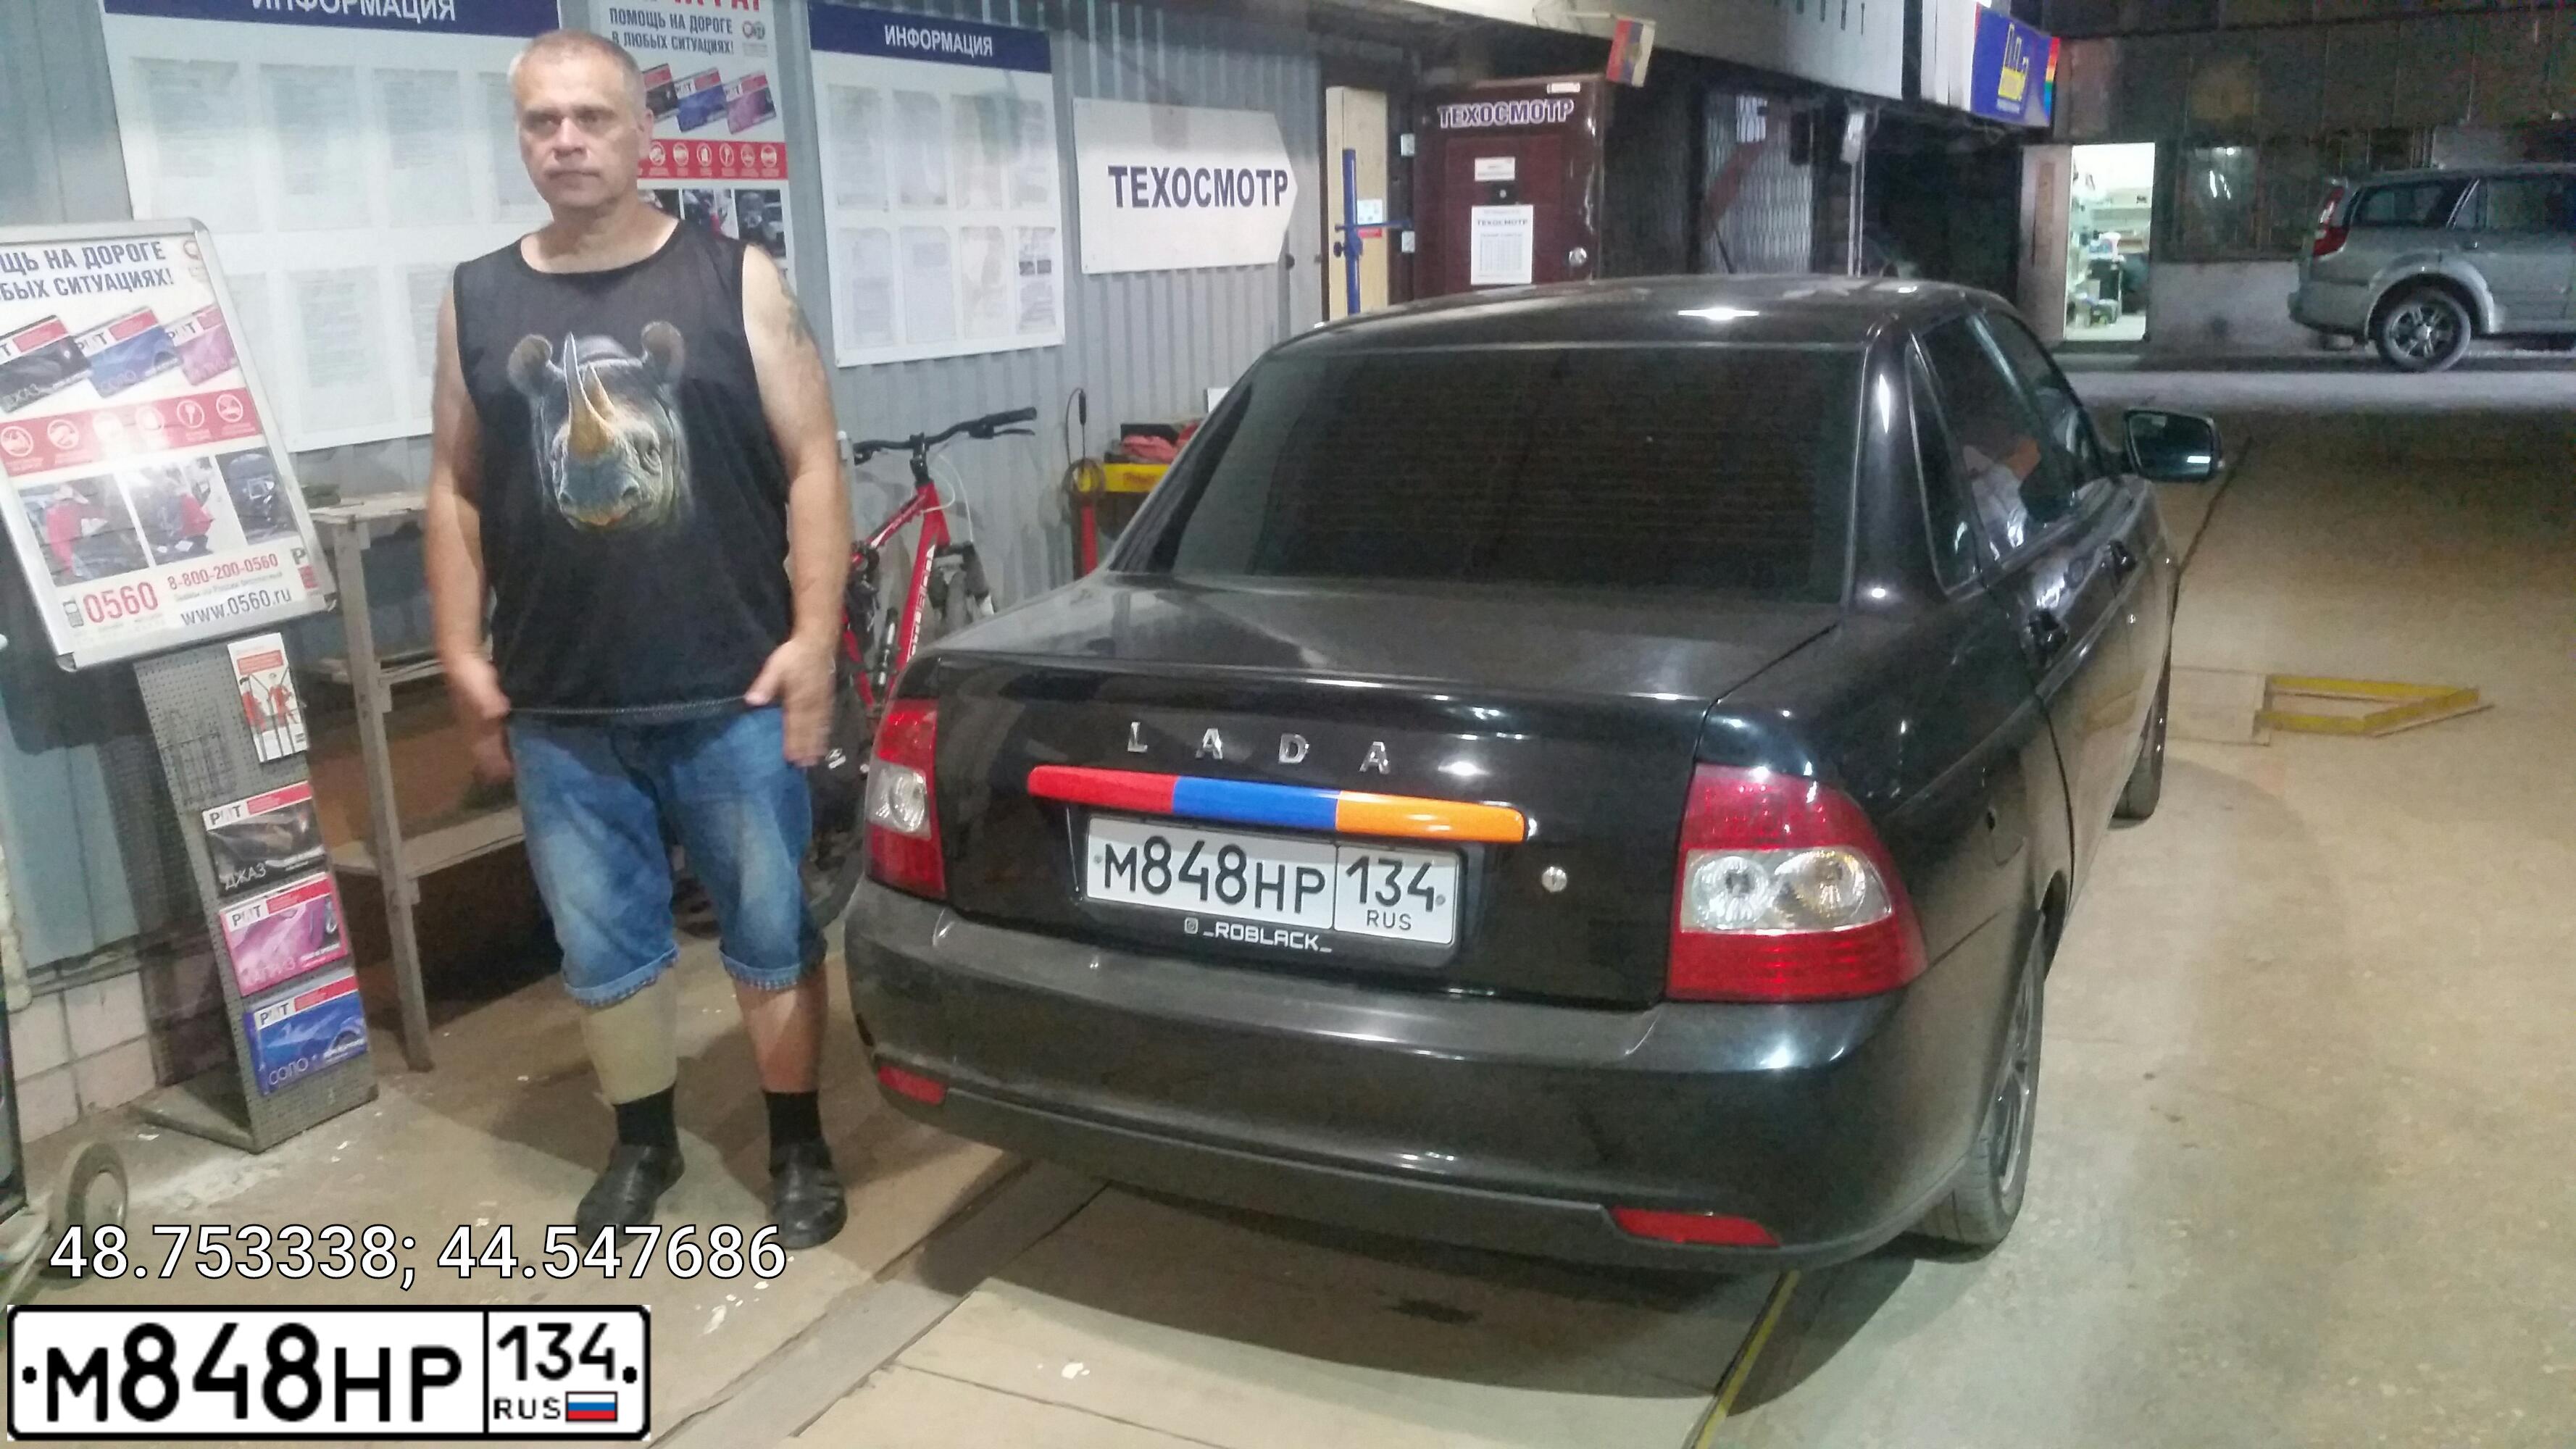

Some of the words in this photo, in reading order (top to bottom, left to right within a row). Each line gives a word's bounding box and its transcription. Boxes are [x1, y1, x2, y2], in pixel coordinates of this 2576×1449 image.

[609, 8, 666, 30] ПОМОЩЬ
[670, 13, 686, 30] НА
[689, 15, 733, 35] ДОРОГЕ
[623, 31, 668, 49] ЛЮБЫХ
[671, 36, 735, 55] СИТУАЦИЯХ!
[884, 24, 993, 58] ИНФОРМАЦИЯ
[1438, 99, 1575, 128] ТЕХОСМОТР
[1107, 165, 1288, 209] ТЕХОСМОТР
[0, 251, 40, 276] ЩЬ
[43, 248, 78, 270] НА
[81, 241, 167, 270] ДОРОГЕ
[0, 280, 50, 302] БЫХ
[54, 267, 175, 297] СИТУАЦИЯХ!
[167, 554, 279, 590] 8-800-200-0560
[83, 581, 159, 624] 0560
[180, 588, 292, 627] www.0560.ru
[1127, 722, 1391, 774] LADA
[1104, 835, 1326, 914] М848НР
[1346, 855, 1435, 912] 134
[1366, 910, 1412, 931] RUS
